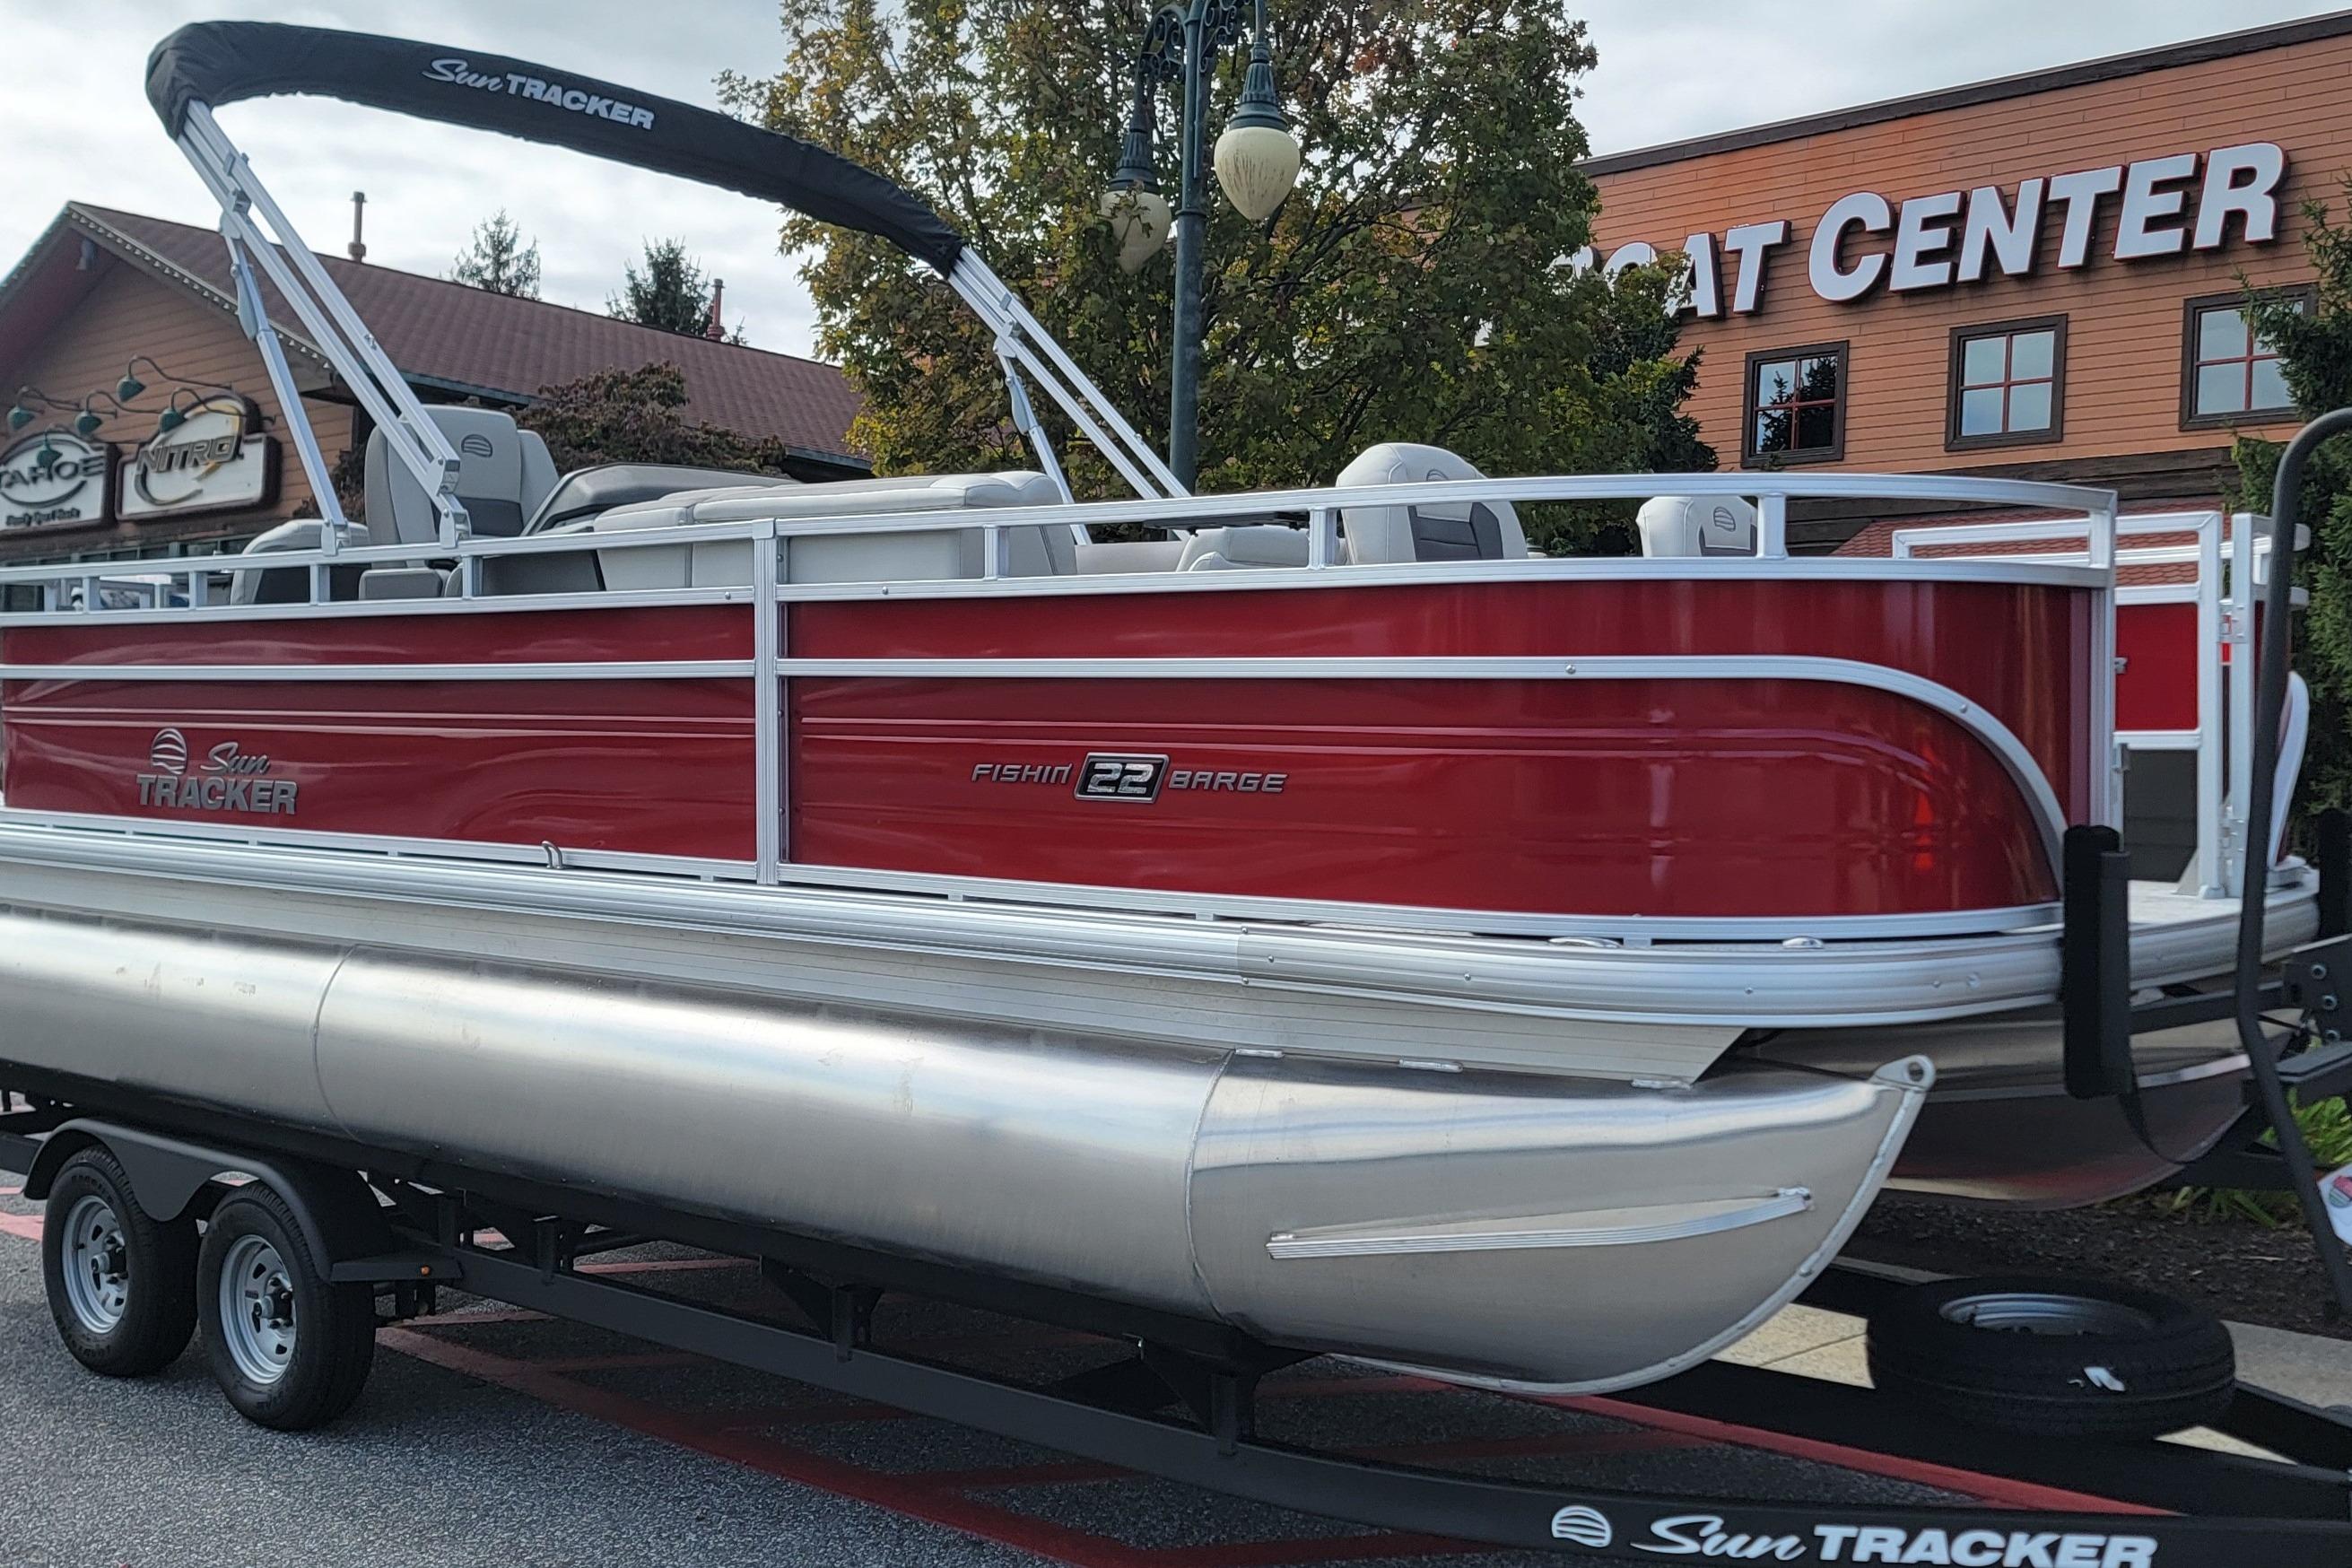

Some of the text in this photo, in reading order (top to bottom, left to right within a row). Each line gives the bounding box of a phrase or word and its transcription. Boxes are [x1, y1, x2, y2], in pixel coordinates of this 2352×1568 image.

[422, 58, 655, 130] Sun TRACKER
[1808, 141, 2287, 302] CENTER
[135, 436, 237, 474] NITRO
[200, 742, 270, 775] Sun
[971, 762, 1288, 795] FISHIN 22 BARGE
[136, 773, 299, 814] TRACKER
[1629, 1514, 2158, 1568] Sun TRACKER
